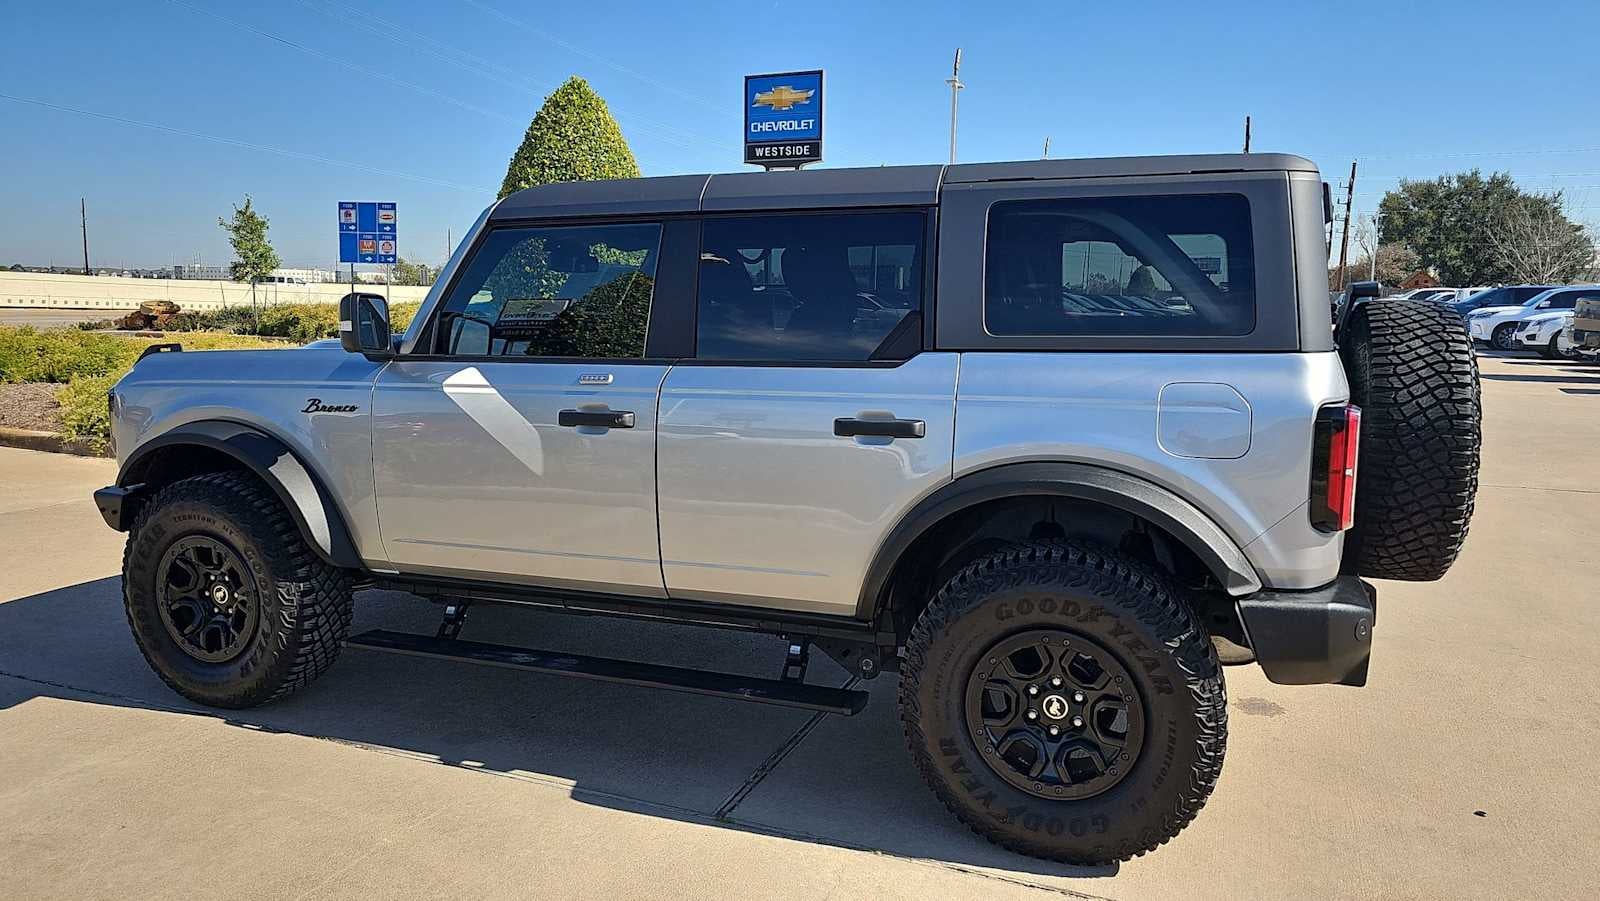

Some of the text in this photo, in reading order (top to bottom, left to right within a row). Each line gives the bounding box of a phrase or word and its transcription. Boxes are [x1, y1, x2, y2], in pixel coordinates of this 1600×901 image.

[751, 120, 815, 132] CHEVROLET
[755, 145, 811, 157] WESTSIDE
[301, 398, 359, 413] Bronco
